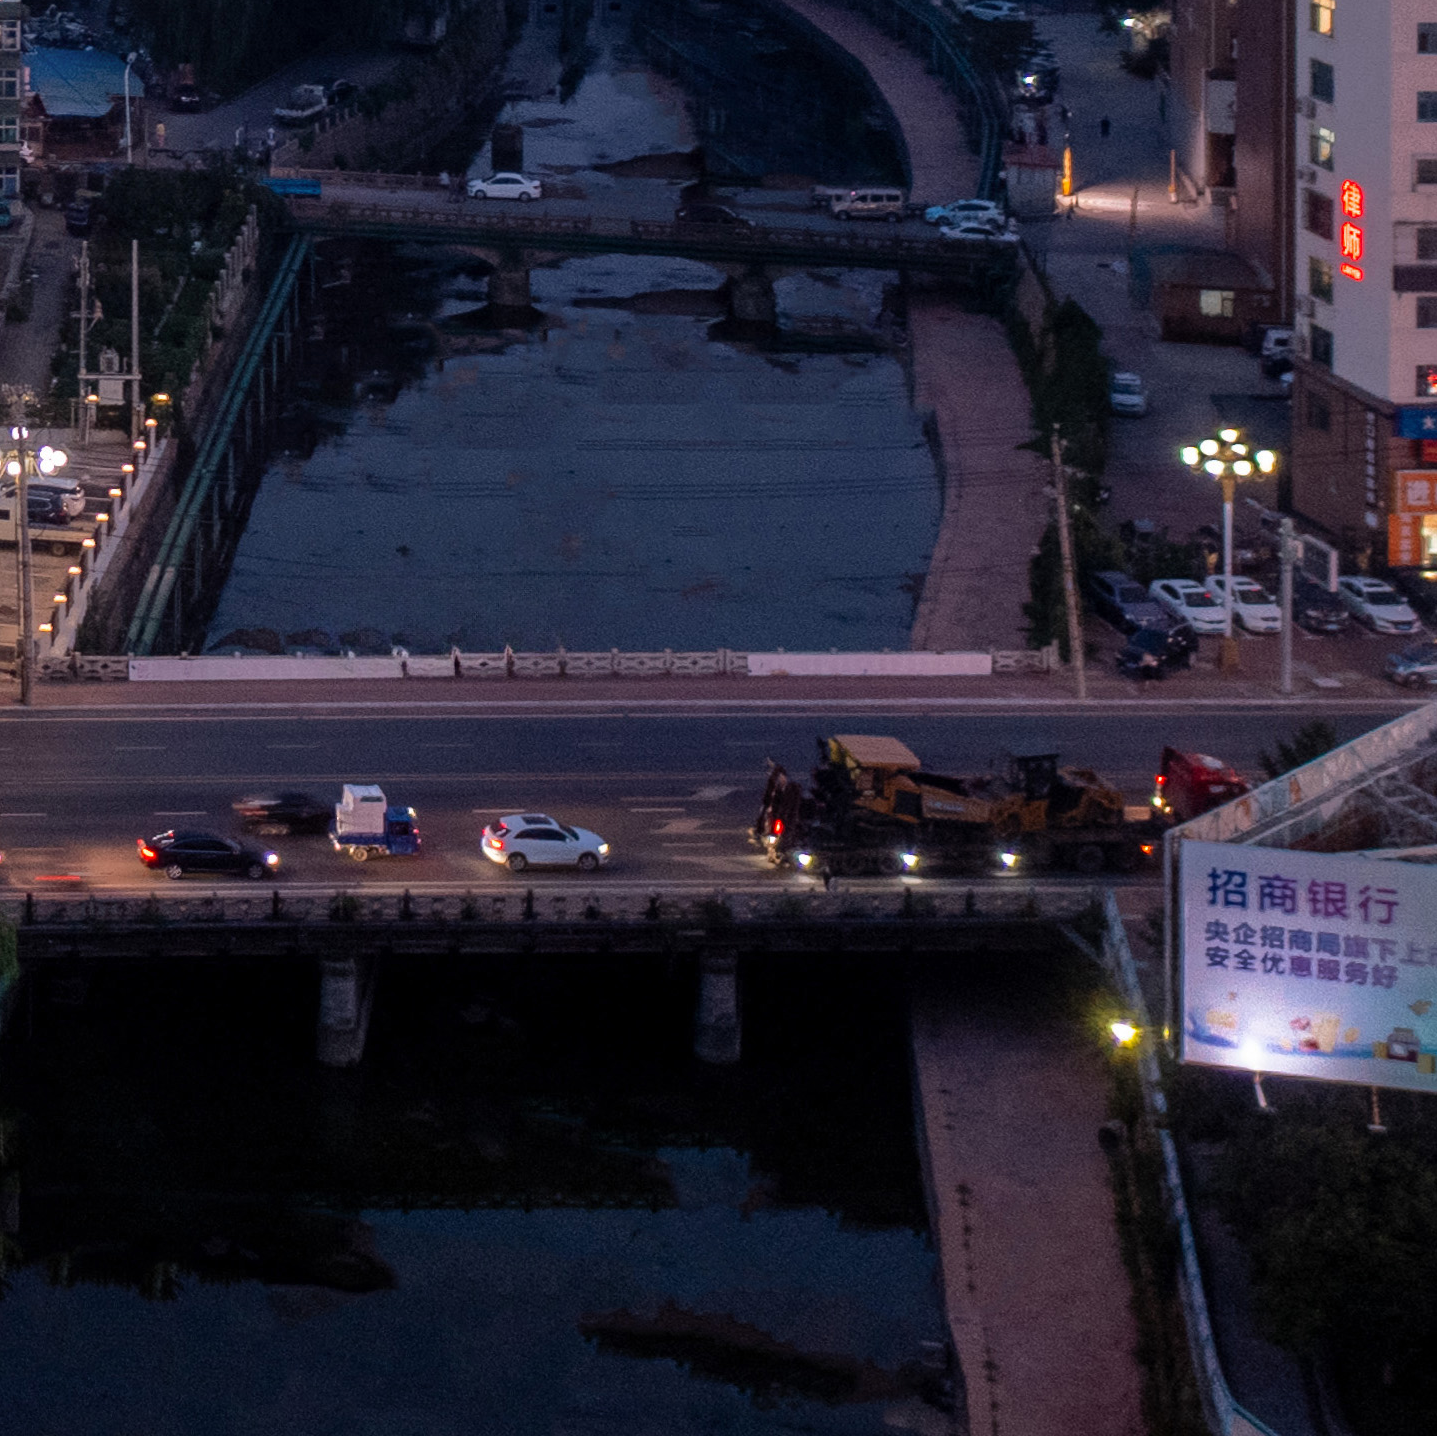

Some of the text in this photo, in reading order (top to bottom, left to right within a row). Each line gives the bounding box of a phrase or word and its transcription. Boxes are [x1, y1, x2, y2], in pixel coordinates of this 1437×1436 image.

[1341, 179, 1363, 261] 律师
[1206, 865, 1400, 926] 招商银行
[1204, 918, 1437, 969] 央企招商局旗下上
[1204, 945, 1399, 990] 安全优惠服务好
